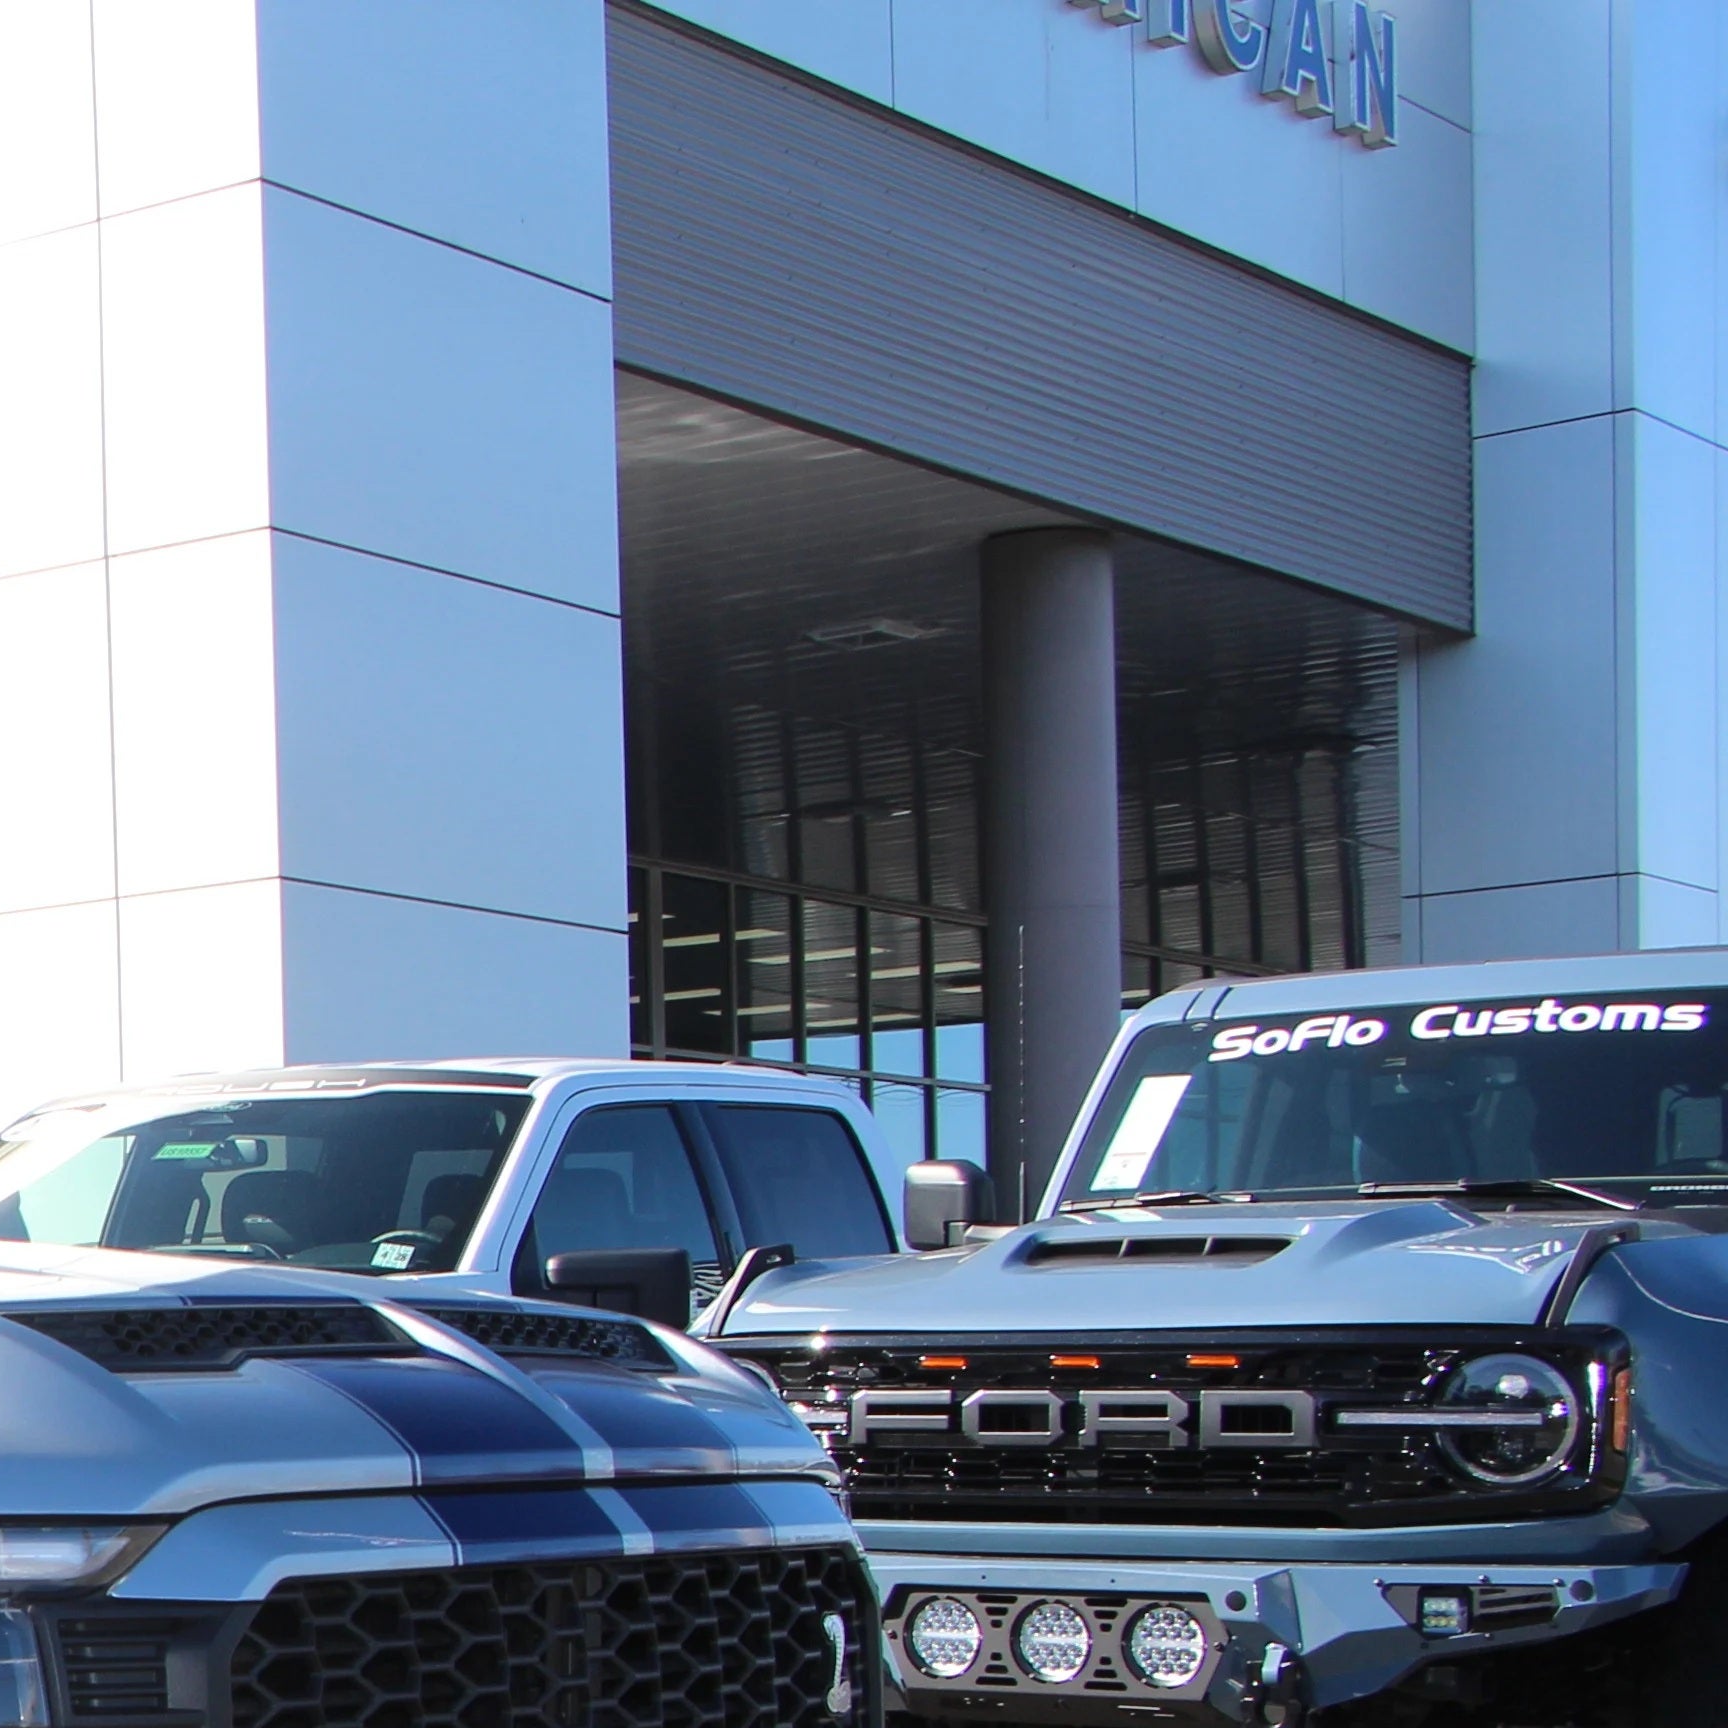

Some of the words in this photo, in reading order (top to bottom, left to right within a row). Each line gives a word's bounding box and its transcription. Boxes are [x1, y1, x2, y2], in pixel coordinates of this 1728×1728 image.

[1207, 1014, 1386, 1063] SoFlo
[1409, 998, 1708, 1042] Customs
[850, 1388, 1317, 1449] FORD
